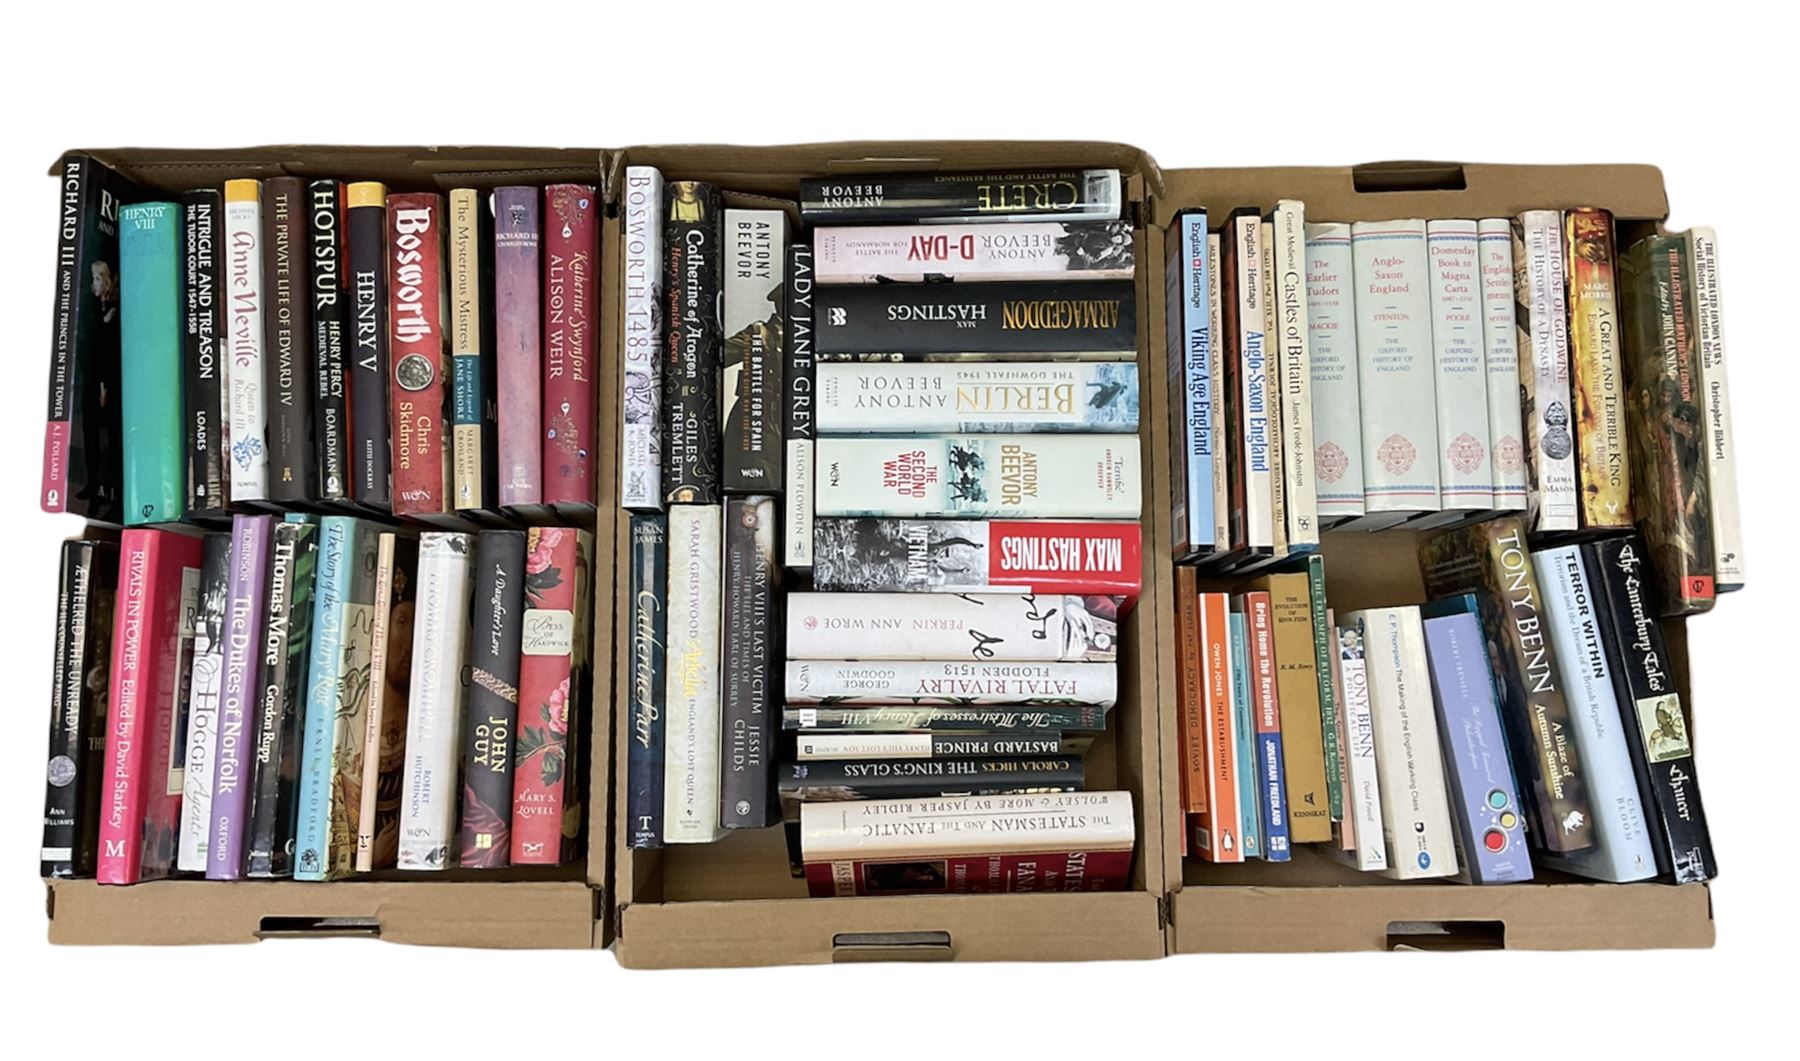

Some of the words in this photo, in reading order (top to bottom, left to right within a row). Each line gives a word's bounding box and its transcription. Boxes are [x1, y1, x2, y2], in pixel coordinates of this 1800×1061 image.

[62, 163, 81, 241] RICHARD
[276, 193, 289, 221] THE
[821, 184, 884, 196] BEEVOR
[821, 196, 885, 209] ANTONY
[978, 181, 1079, 212] CRETE
[125, 207, 165, 220] HENRY
[134, 219, 156, 230] VIII
[457, 196, 469, 222] The
[197, 204, 212, 269] INTRIGUE
[277, 224, 290, 275] PRIVATE
[313, 191, 337, 311] HOTSPUR
[627, 176, 651, 300] BOSWORTH
[737, 222, 753, 279] BEEVOR
[755, 221, 771, 280] ANTONY
[907, 234, 975, 262] D-DAY
[981, 234, 1052, 248] BEEVOR
[988, 248, 1045, 260] ANTONY
[1189, 222, 1203, 258] English
[1431, 245, 1476, 257] Domesday
[61, 246, 77, 265] III
[232, 230, 256, 288] Anne
[456, 225, 471, 300] Mysterious
[685, 229, 706, 308] Catherine
[62, 270, 72, 292] AND
[198, 272, 212, 307] AND
[394, 206, 432, 343] Bosworth
[549, 254, 565, 324] ALISON
[793, 251, 813, 309] LADY
[1189, 268, 1203, 309] Heritage
[1369, 284, 1409, 296] England
[1374, 270, 1404, 281] Saxon
[1441, 271, 1471, 283] Magna
[1444, 284, 1470, 294] Carta
[61, 292, 70, 310] THE
[277, 281, 291, 305] LIFE
[356, 270, 378, 350] HENRY
[234, 290, 259, 368] Neville
[278, 308, 291, 326] OF
[458, 301, 472, 350] Mistress
[682, 309, 700, 324] of
[887, 304, 986, 322] HASTINGS
[956, 319, 977, 329] MAX
[1001, 300, 1121, 330] ARMAGEDDON
[1598, 306, 1611, 319] A
[58, 312, 70, 350] PRINCES
[199, 310, 214, 379] TREASON
[318, 320, 328, 368] MEDIEVAL
[329, 320, 342, 361] HENRY
[627, 310, 651, 363] 1485
[751, 333, 764, 353] THE
[789, 315, 812, 369] JANE
[1187, 327, 1209, 370] Viking
[1599, 321, 1613, 362] GREAT
[57, 351, 68, 363] IN
[279, 329, 292, 390] EDWARD
[358, 354, 378, 373] V
[550, 328, 565, 380] WEIR
[682, 325, 704, 379] Aragon
[56, 365, 66, 383] THE
[319, 370, 329, 400] REBEL
[330, 362, 343, 398] PERCY
[455, 358, 464, 383] JANE
[751, 356, 764, 394] BATTLE
[858, 376, 942, 390] BEEVOR
[955, 370, 981, 380] 1945
[984, 371, 1048, 380] DOWNFALL
[1052, 371, 1075, 380] THE
[1187, 371, 1211, 399] Age
[1243, 330, 1267, 414] Anglo-Saxon
[1601, 364, 1615, 391] AND
[54, 386, 65, 418] TOWER
[279, 391, 293, 406] IV
[456, 385, 465, 420] SHORE
[751, 397, 764, 417] FOR
[792, 375, 811, 437] GREY
[853, 394, 948, 408] ANTONY
[955, 383, 1075, 415] BERLIN
[196, 410, 207, 451] LOADES
[325, 408, 338, 473] BOARDMAN
[399, 401, 415, 470] Skidmore
[416, 415, 432, 455] Chris
[685, 417, 699, 463] GILES
[751, 419, 764, 452] SPAIN
[1189, 400, 1212, 457] England
[1604, 393, 1619, 452] TERRIBLE
[456, 430, 465, 476] CROSLAND
[466, 429, 475, 475] MARGARET
[671, 402, 685, 484] TREMLETT
[1246, 416, 1269, 472] England
[795, 442, 806, 481] ALISON
[883, 460, 898, 488] WAR
[897, 453, 912, 497] WORLD
[910, 450, 926, 499] SECOND
[924, 465, 939, 484] THE
[1000, 444, 1022, 506] BEEVOR
[1021, 451, 1038, 498] ANTONY
[1608, 452, 1622, 488] KING
[795, 483, 806, 535] PLOWDEN
[240, 527, 253, 581] ROBINSON
[690, 518, 701, 559] SARAH
[906, 524, 929, 584] VIETNAM
[1000, 536, 1078, 571] HASTINGS
[1084, 538, 1123, 573] MAX
[129, 550, 145, 597] RIVALS
[269, 540, 296, 612] Thomas
[1495, 528, 1537, 612] TONY
[127, 600, 141, 617] IN
[233, 594, 253, 629] The
[688, 561, 700, 640] GRISTWOOD
[1255, 601, 1267, 629] Bring
[1564, 550, 1591, 618] TERROR
[1581, 618, 1606, 680] WITHIN
[265, 615, 288, 666] More
[823, 617, 865, 630] WROE
[870, 618, 903, 630] ANN
[912, 618, 964, 631] PERKIN
[122, 620, 140, 672] POWER
[1257, 629, 1269, 657] Home
[1514, 614, 1556, 694] BENN
[227, 634, 248, 694] Dukes
[837, 669, 896, 680] GOODWIN
[1259, 658, 1270, 675] the
[115, 679, 136, 719] Edited
[843, 679, 891, 690] GEORGE
[916, 678, 1005, 695] RIVALRY
[1009, 679, 1078, 695] FATAL
[1261, 675, 1275, 728] Revolution
[1351, 663, 1370, 710] TONY
[224, 696, 243, 718] of
[263, 684, 280, 730] Gordon
[115, 721, 134, 738] by
[256, 731, 276, 764] Rupp
[474, 724, 491, 766] GUY
[488, 715, 509, 774] JOHN
[733, 718, 746, 773] CHILDS
[747, 724, 761, 767] JESSIE
[934, 741, 990, 754] PRINCE
[994, 740, 1059, 754] BASTARD
[1356, 713, 1376, 759] BENN
[115, 741, 131, 778] David
[218, 721, 241, 795] Norfolk
[843, 764, 891, 777] GLASS
[892, 762, 944, 776] KING'S
[946, 761, 978, 774] THE
[981, 762, 1018, 772] HICKS
[1019, 760, 1071, 771] CAROLA
[411, 755, 423, 818] HUTCHINSON
[421, 769, 433, 804] ROBERT
[108, 781, 128, 829] Starkey
[216, 815, 230, 861] OXFORD
